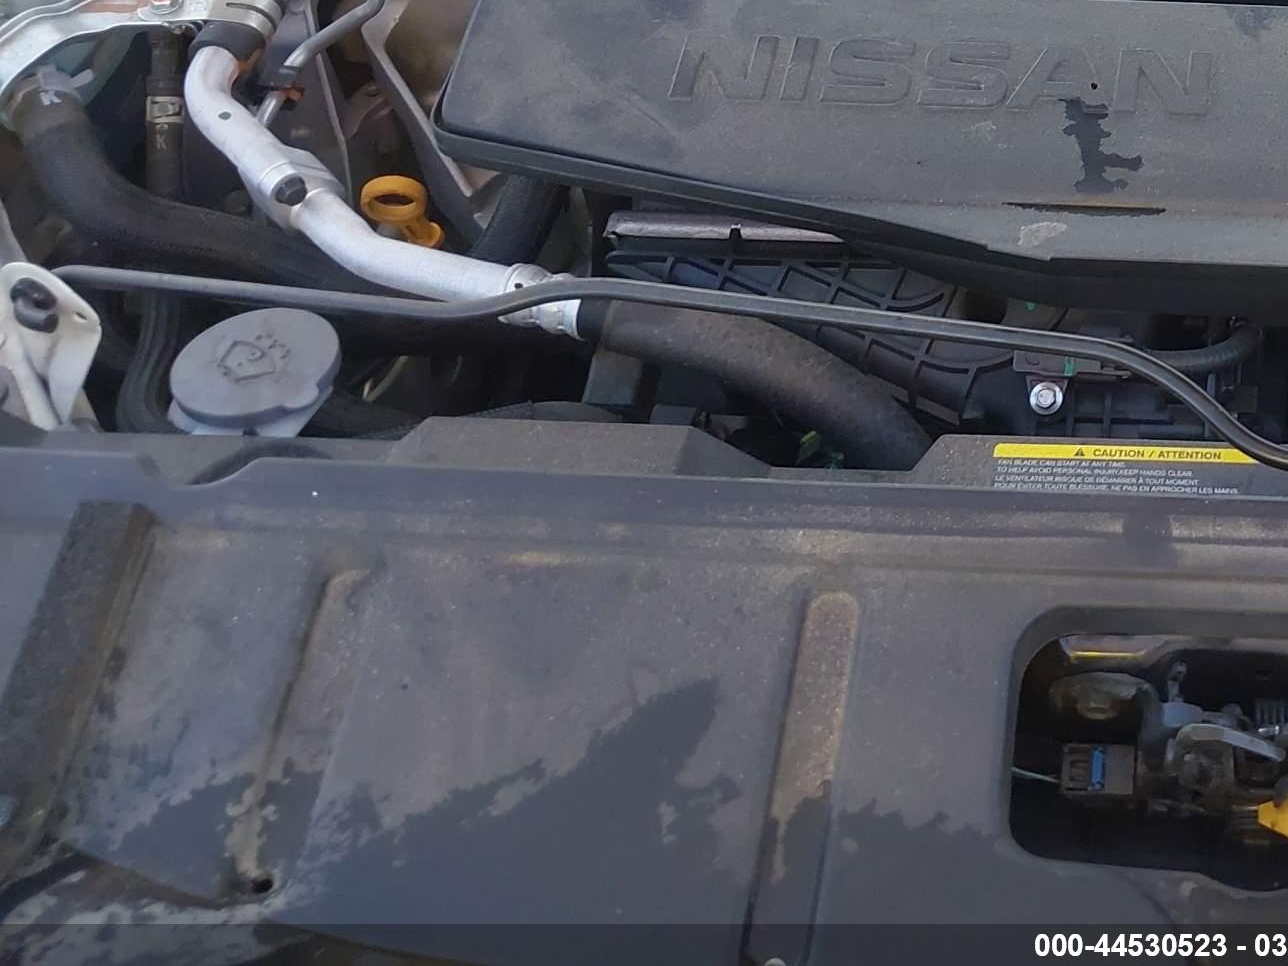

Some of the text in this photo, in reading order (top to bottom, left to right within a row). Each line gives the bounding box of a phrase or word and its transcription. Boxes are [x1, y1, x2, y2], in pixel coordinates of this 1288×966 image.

[668, 34, 1216, 117] NISSAN
[1093, 449, 1146, 458] CAUTION
[1158, 450, 1221, 460] ATTENTION
